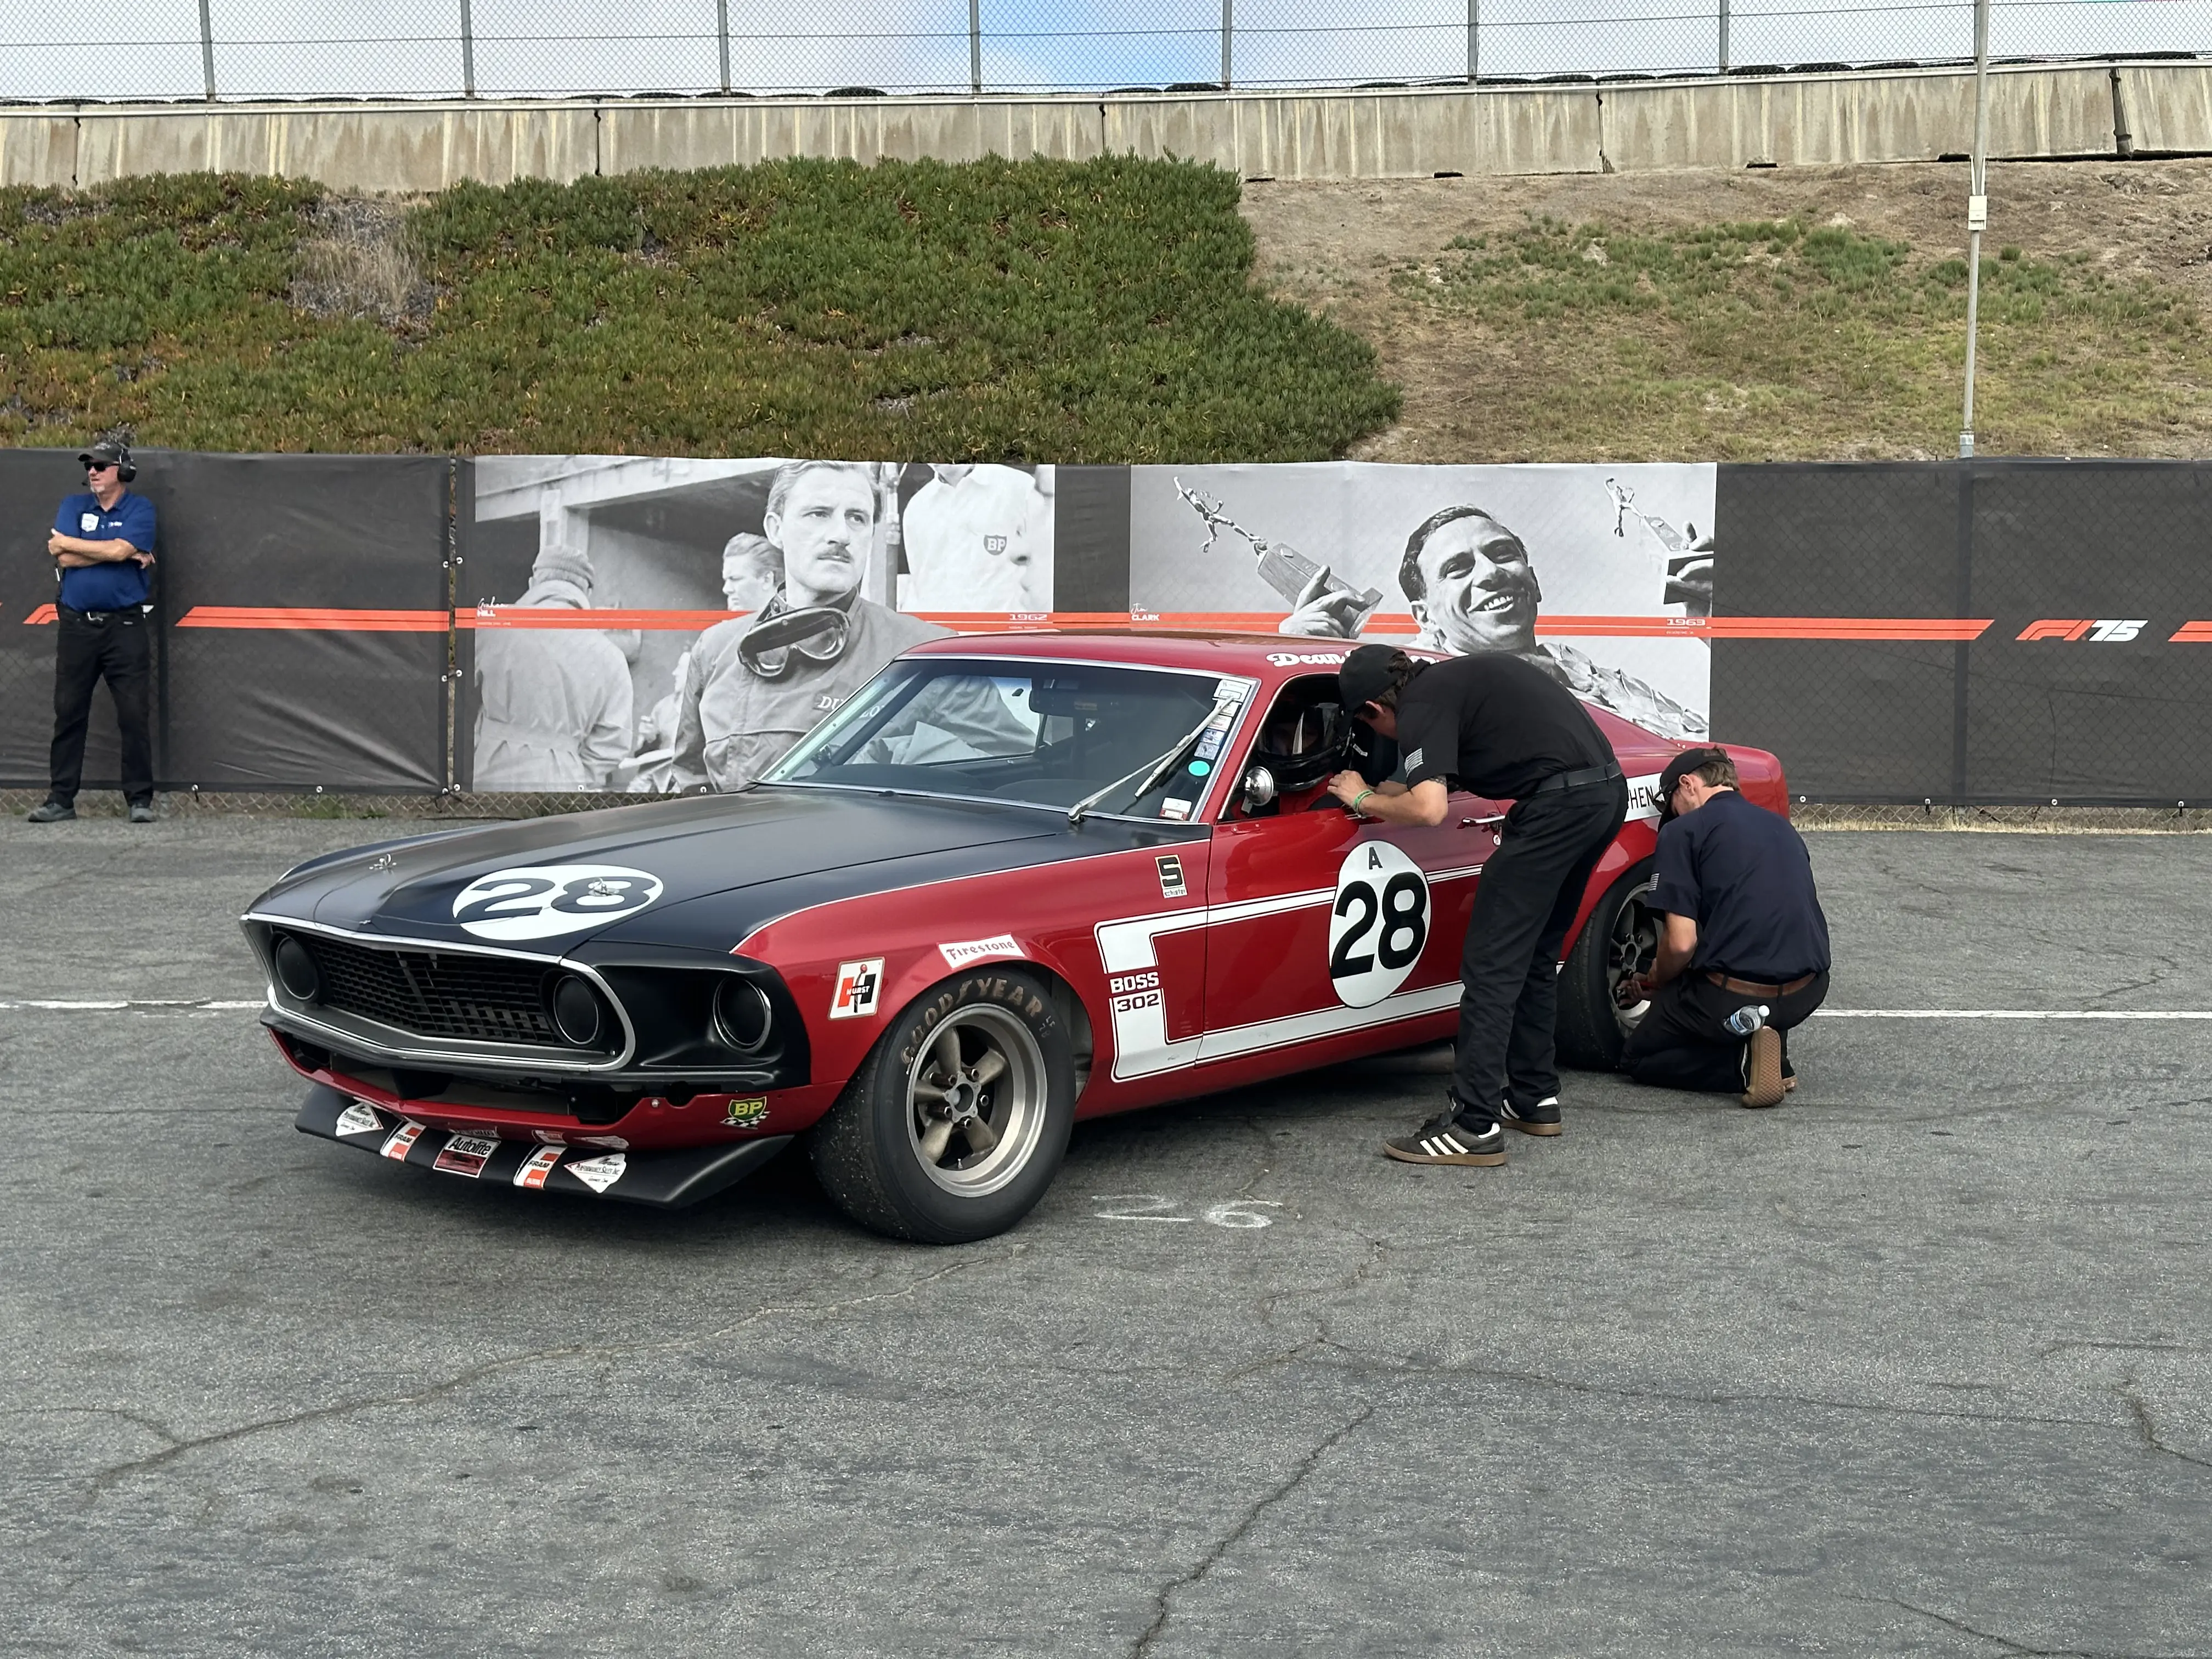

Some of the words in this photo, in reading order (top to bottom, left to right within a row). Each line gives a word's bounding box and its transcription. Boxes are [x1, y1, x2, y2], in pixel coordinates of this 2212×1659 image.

[987, 537, 1006, 551] BP
[1666, 618, 1706, 626] 1963
[1368, 846, 1383, 870] A
[454, 876, 658, 924] 28
[1330, 871, 1427, 979] 28
[946, 941, 1015, 960] Firestone
[846, 985, 870, 996] HURST
[1110, 971, 1160, 995] BOSS
[1116, 993, 1160, 1013] 302
[733, 1101, 763, 1116] BP
[394, 1133, 414, 1143] FRAM
[448, 1136, 492, 1156] Autolite
[527, 1160, 551, 1169] FRAM
